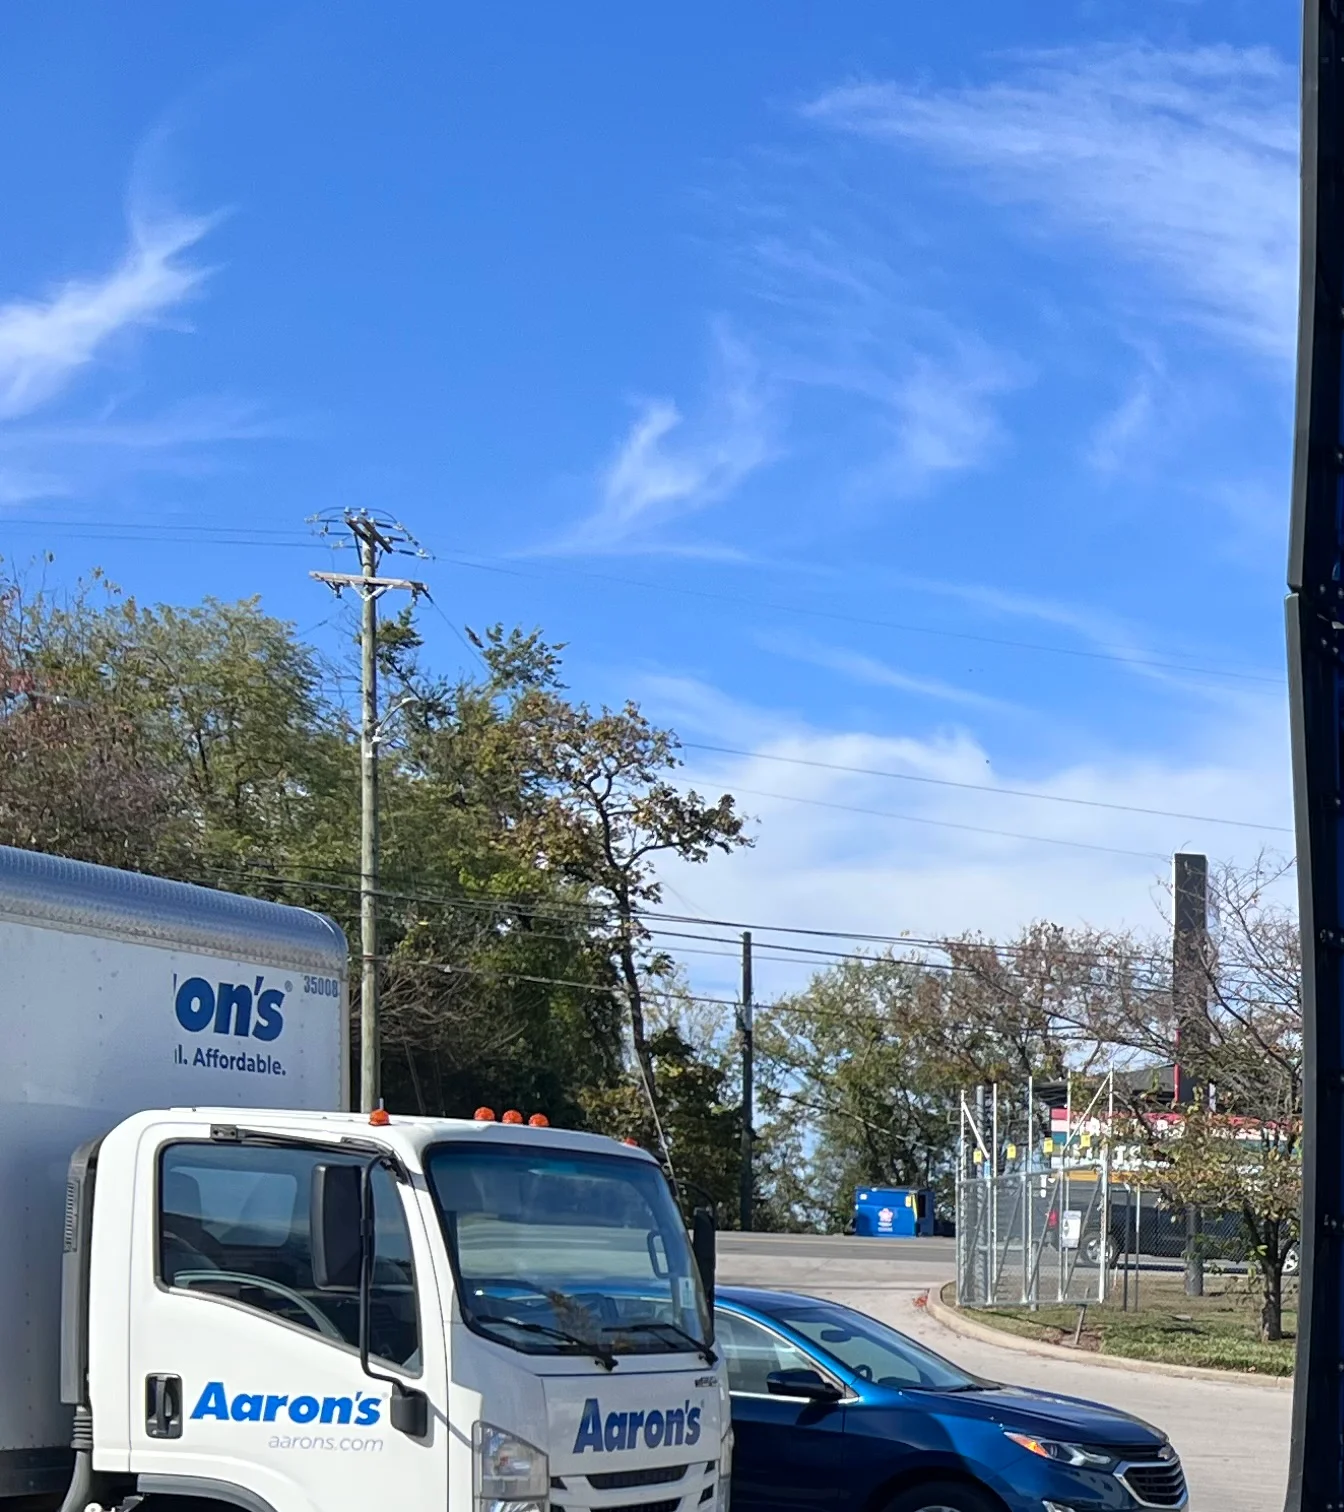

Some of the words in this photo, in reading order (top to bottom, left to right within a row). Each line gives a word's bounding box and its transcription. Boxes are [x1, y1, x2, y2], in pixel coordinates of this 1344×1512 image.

[173, 973, 286, 1042] on's
[192, 1047, 287, 1077] Affordable.
[189, 1381, 383, 1427] Aaron's
[572, 1397, 702, 1454] Aaron's
[267, 1433, 385, 1452] aarons.com
